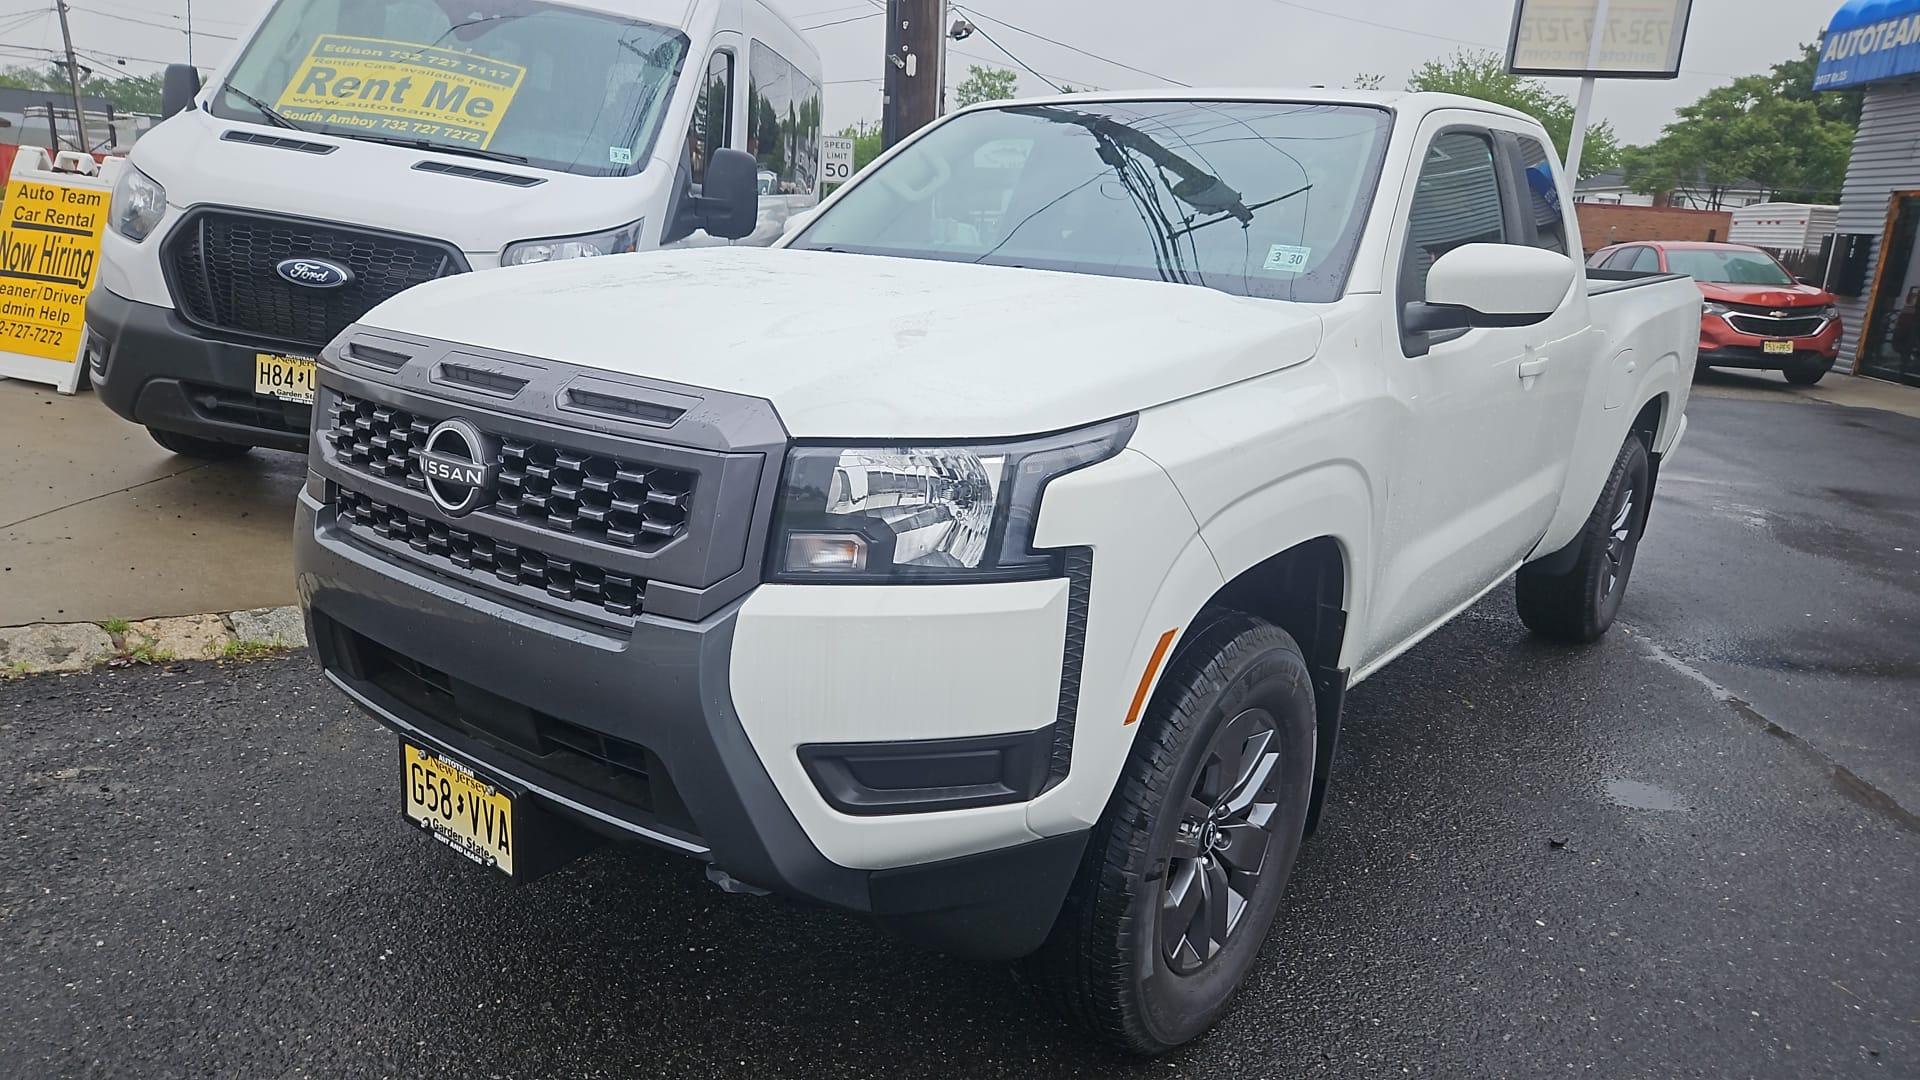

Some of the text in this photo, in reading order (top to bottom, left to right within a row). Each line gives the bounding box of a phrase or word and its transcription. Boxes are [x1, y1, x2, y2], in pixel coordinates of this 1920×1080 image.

[314, 58, 360, 68] Rental
[363, 61, 397, 71] Cars
[400, 66, 465, 82] available
[323, 43, 511, 79] Edison 732 727 7117
[296, 66, 495, 119] Rent Me
[293, 97, 486, 128] www.autoteam.com
[282, 109, 481, 143] South Amboy 732 727 7272
[824, 141, 852, 150] SPEED
[826, 152, 848, 161] LIMIT
[825, 163, 849, 178] 50
[17, 184, 101, 207] Auto Team
[14, 205, 95, 228] Car Rental
[0, 229, 95, 289] Now Hiring
[1272, 251, 1303, 265] 3 30
[290, 262, 329, 282] Ford
[0, 301, 70, 326] dmin Help
[260, 362, 294, 389] H84
[276, 388, 303, 398] Garden
[419, 456, 482, 485] NISSAN
[430, 758, 488, 797] New Jersey
[438, 754, 475, 778] AUTOTEAM
[411, 762, 510, 857] G58 VVA
[432, 818, 490, 859] Garden State
[434, 831, 483, 865] RENT AND LEASE
